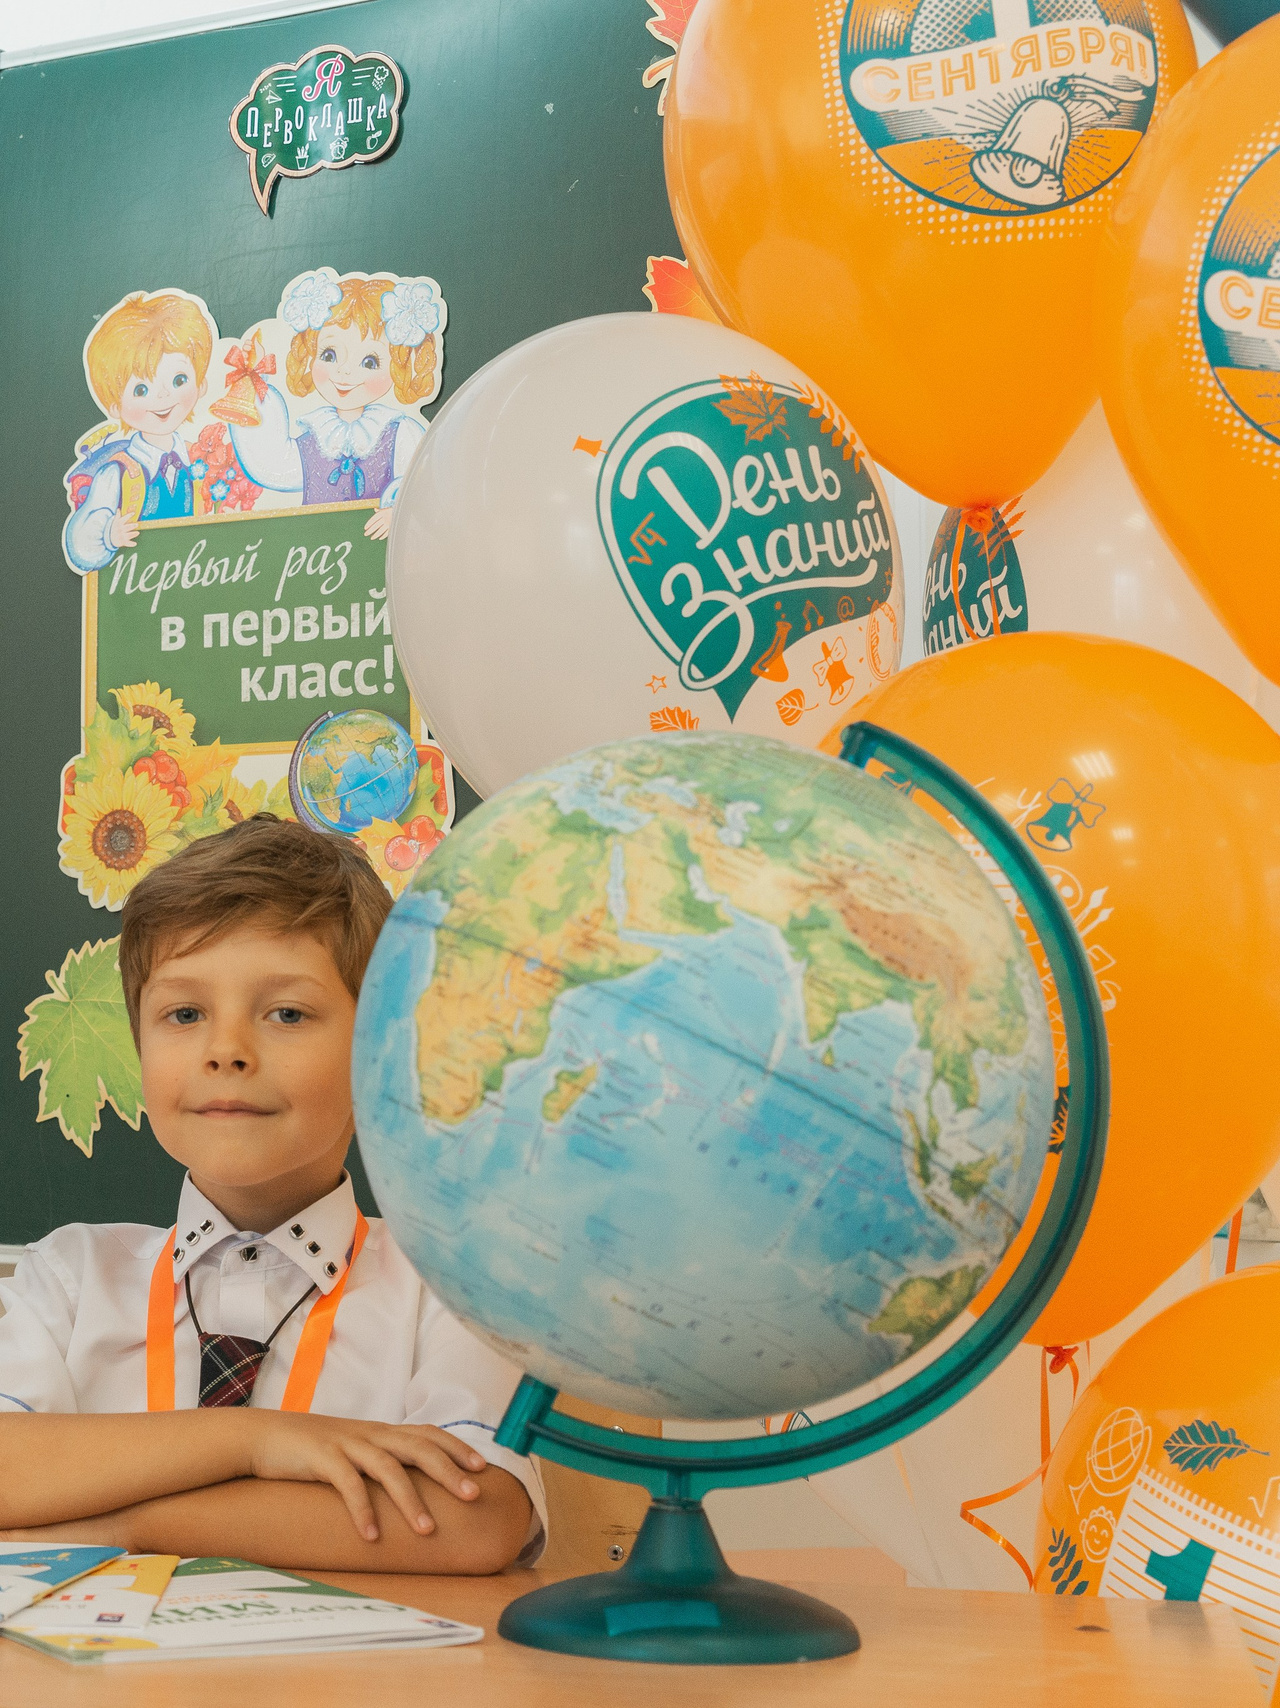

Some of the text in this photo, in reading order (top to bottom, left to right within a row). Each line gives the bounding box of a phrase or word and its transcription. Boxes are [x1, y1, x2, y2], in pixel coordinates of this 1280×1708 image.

[302, 54, 345, 102] Я
[862, 27, 1149, 103] СЕНТЯБРЯ!
[619, 431, 841, 550] День
[108, 539, 353, 614] Первый раз
[660, 492, 890, 690] Знаний
[160, 616, 187, 652] в
[240, 644, 395, 703] класс!
